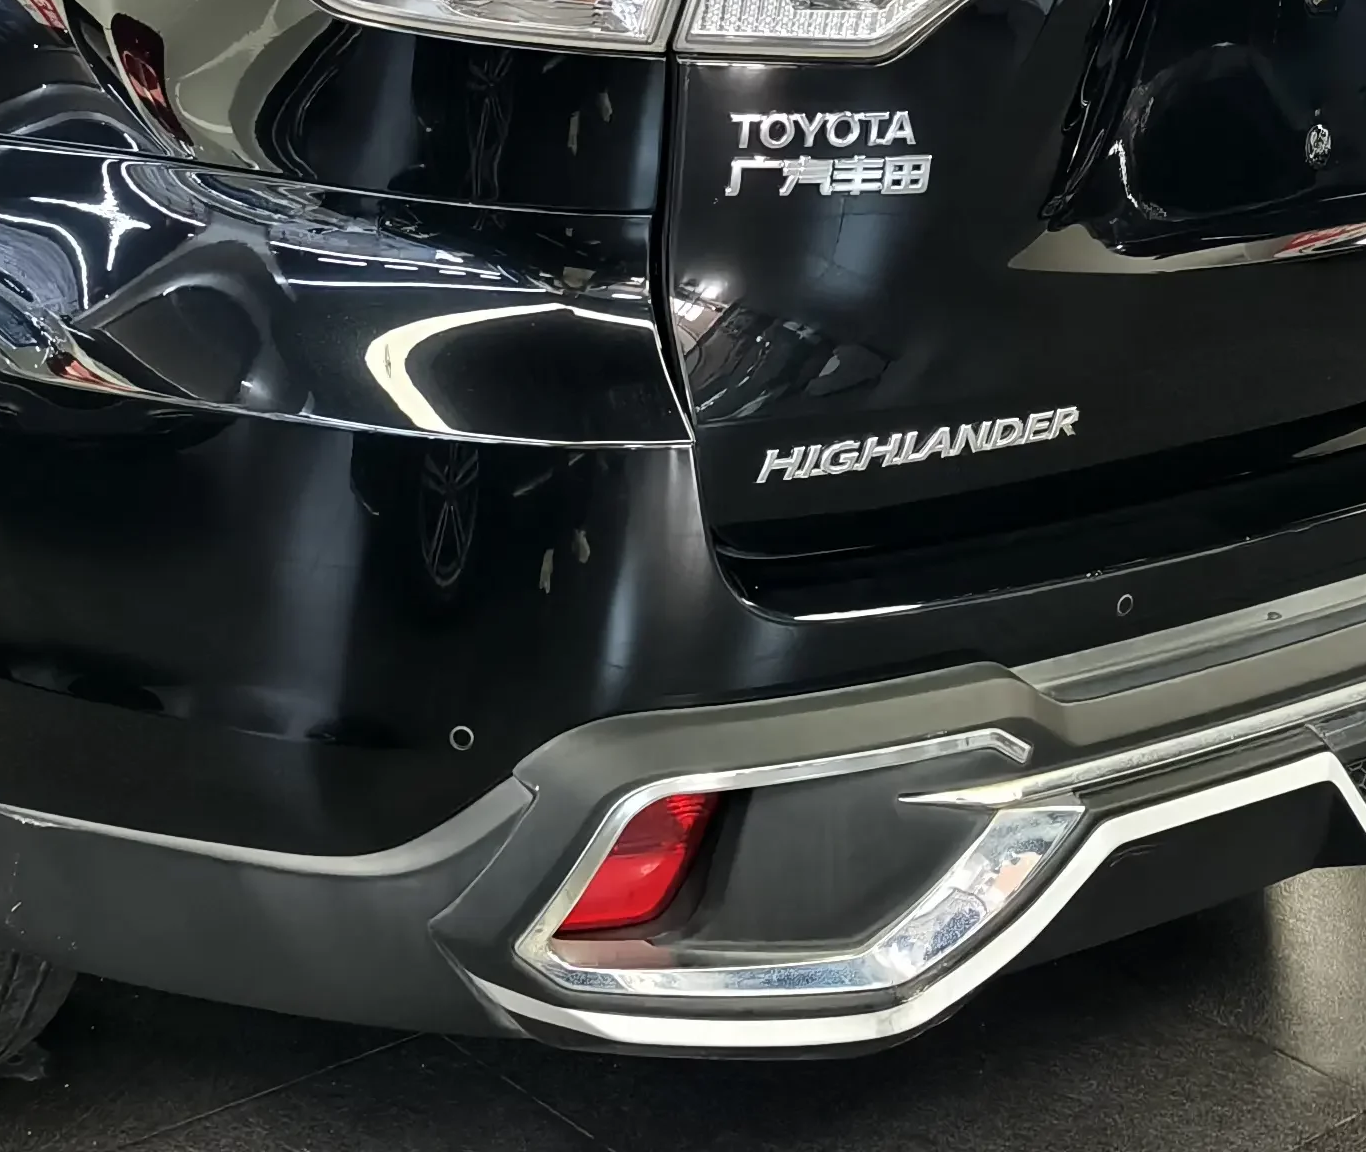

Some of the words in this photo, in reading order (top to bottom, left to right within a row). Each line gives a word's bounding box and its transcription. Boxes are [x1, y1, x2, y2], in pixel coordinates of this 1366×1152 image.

[729, 110, 917, 149] TOYOTA
[724, 154, 933, 197] 广汽丰田
[754, 405, 1080, 484] HIGHLANDER
